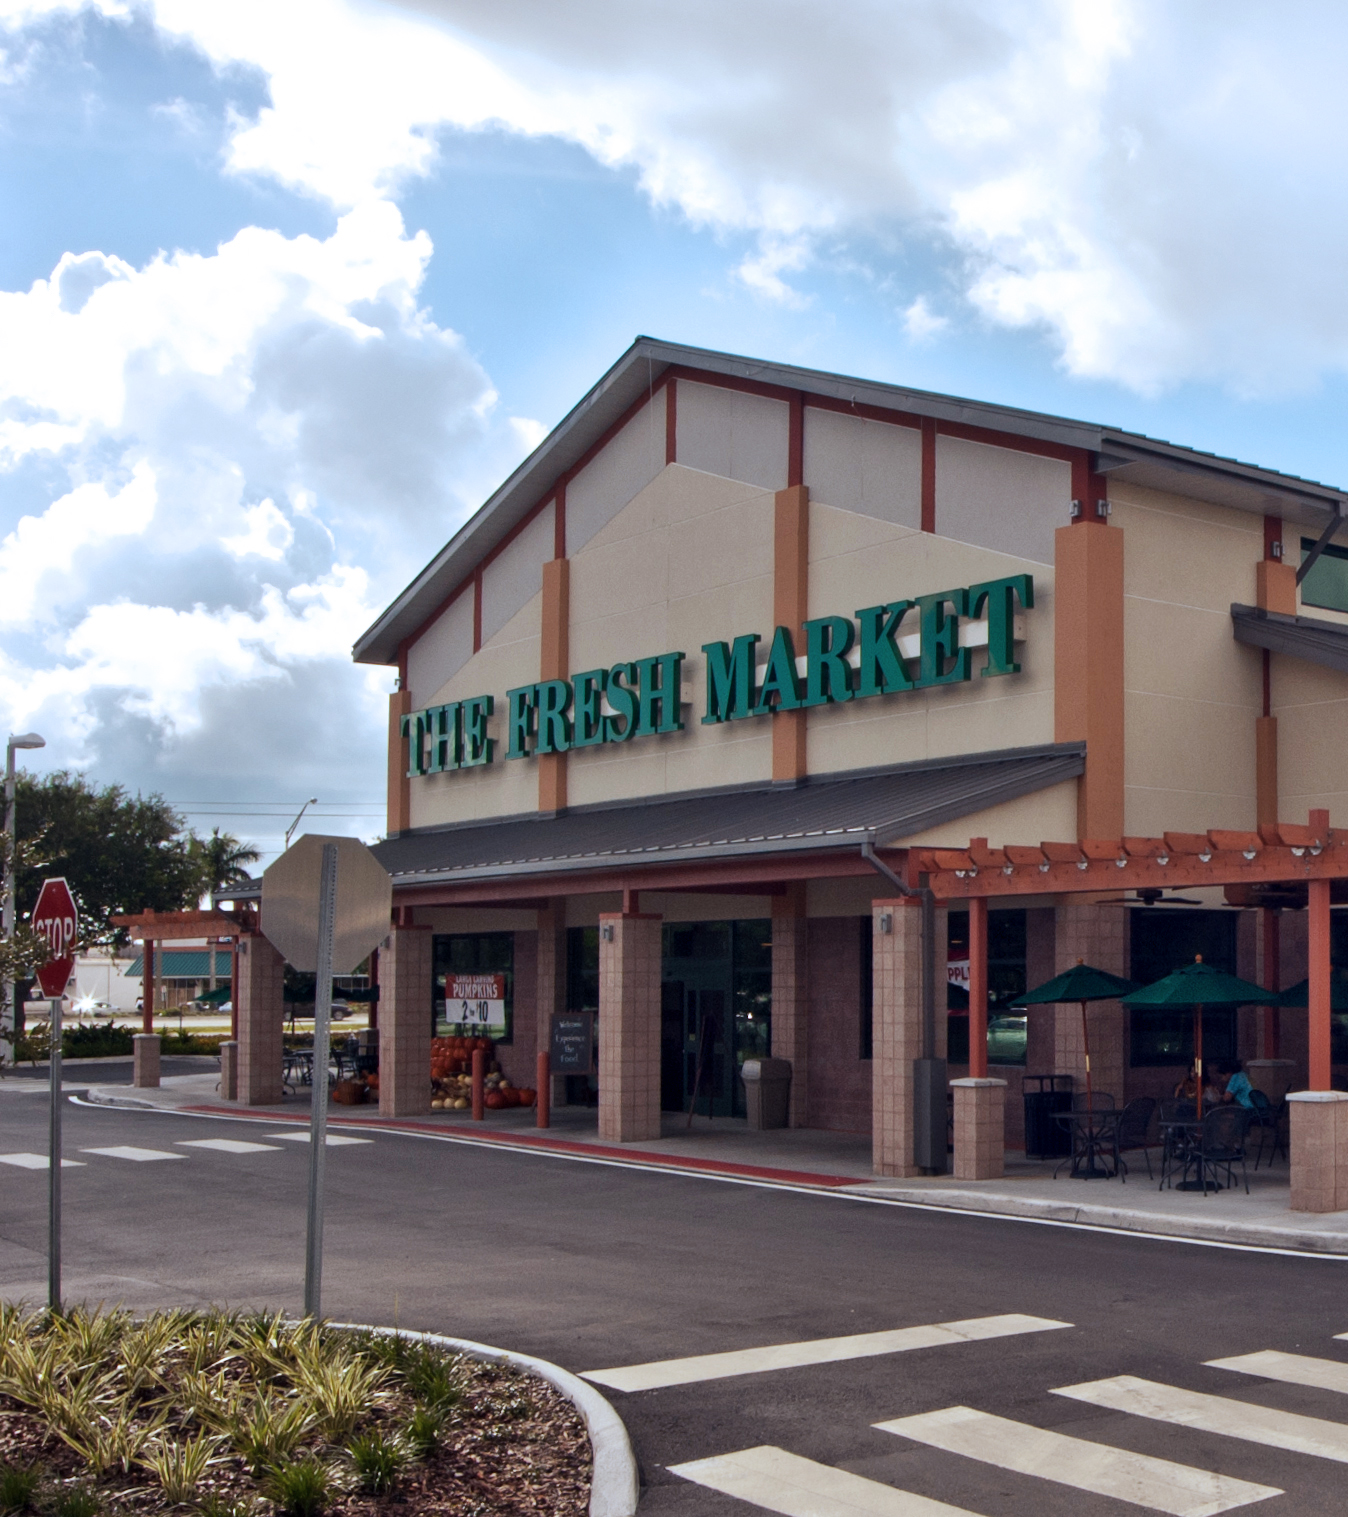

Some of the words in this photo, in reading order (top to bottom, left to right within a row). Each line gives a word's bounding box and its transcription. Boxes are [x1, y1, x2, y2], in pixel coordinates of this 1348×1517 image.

[400, 695, 494, 778] THE
[505, 651, 685, 760] FRESH
[701, 574, 1034, 724] MARKET
[37, 917, 74, 961] TOP
[948, 966, 970, 981] PPL
[453, 983, 498, 998] PUMPKINS
[462, 1000, 468, 1021] 2
